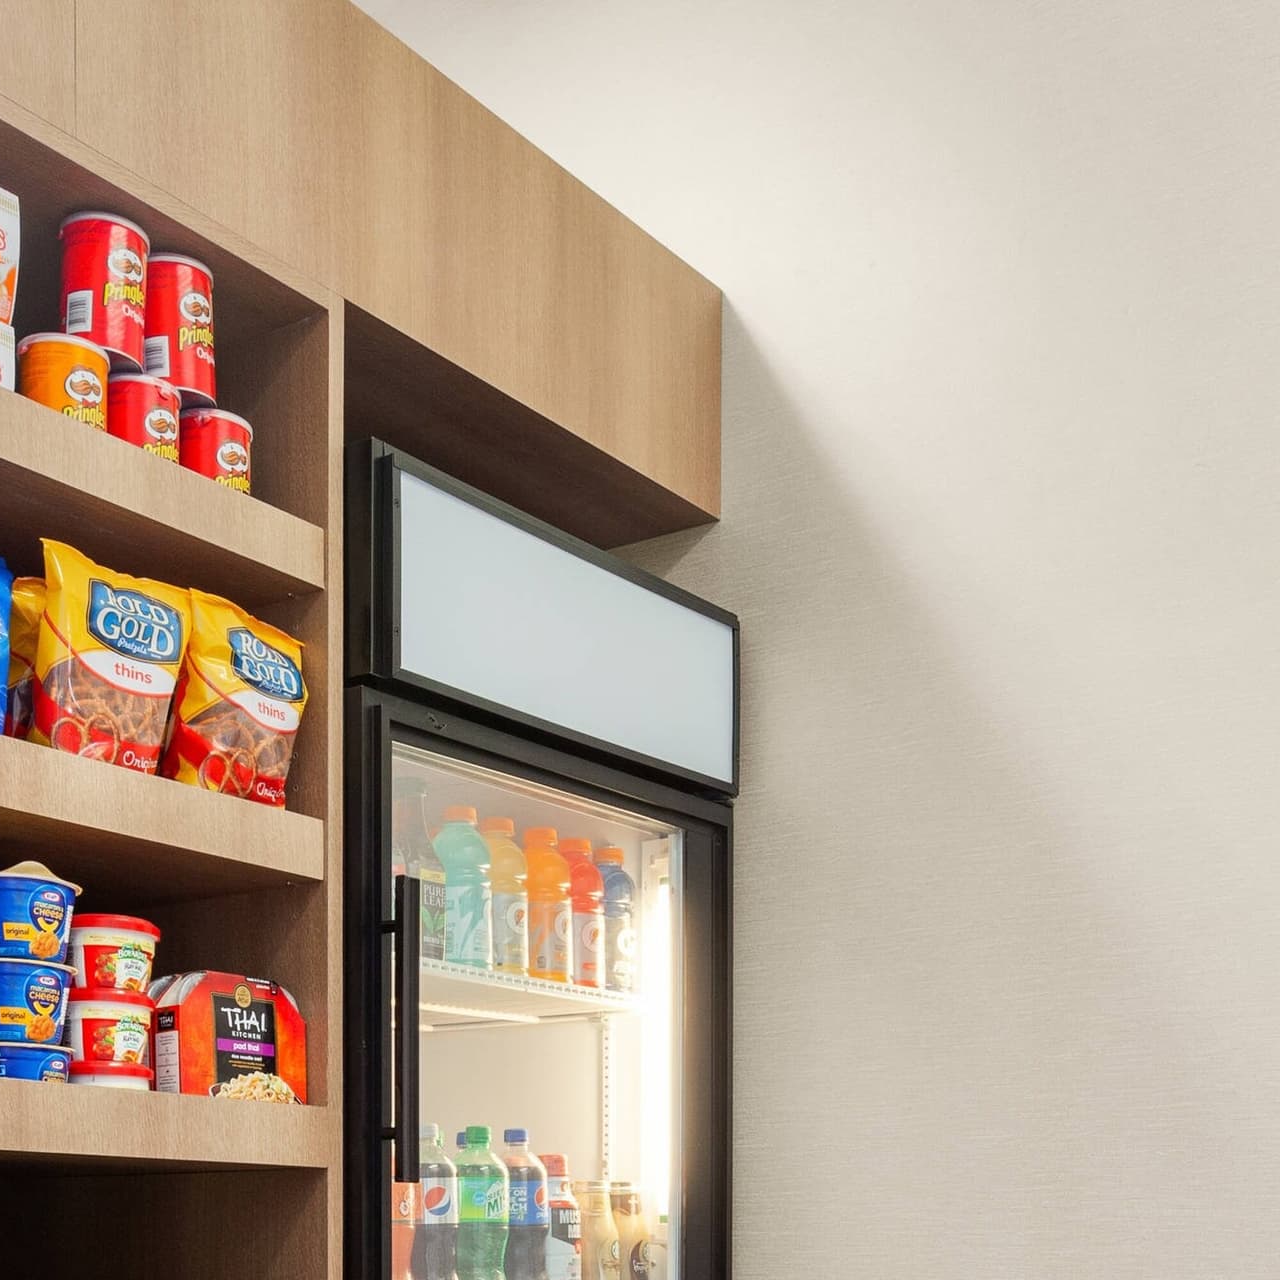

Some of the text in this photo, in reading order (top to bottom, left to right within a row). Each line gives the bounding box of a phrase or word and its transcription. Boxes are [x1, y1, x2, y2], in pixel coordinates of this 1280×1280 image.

[97, 607, 175, 657] GOLD
[114, 661, 152, 684] thins
[240, 654, 298, 695] GOLD
[257, 701, 286, 722] thins
[423, 883, 446, 898] PURE
[221, 1007, 267, 1033] THAI
[233, 1042, 248, 1052] pad
